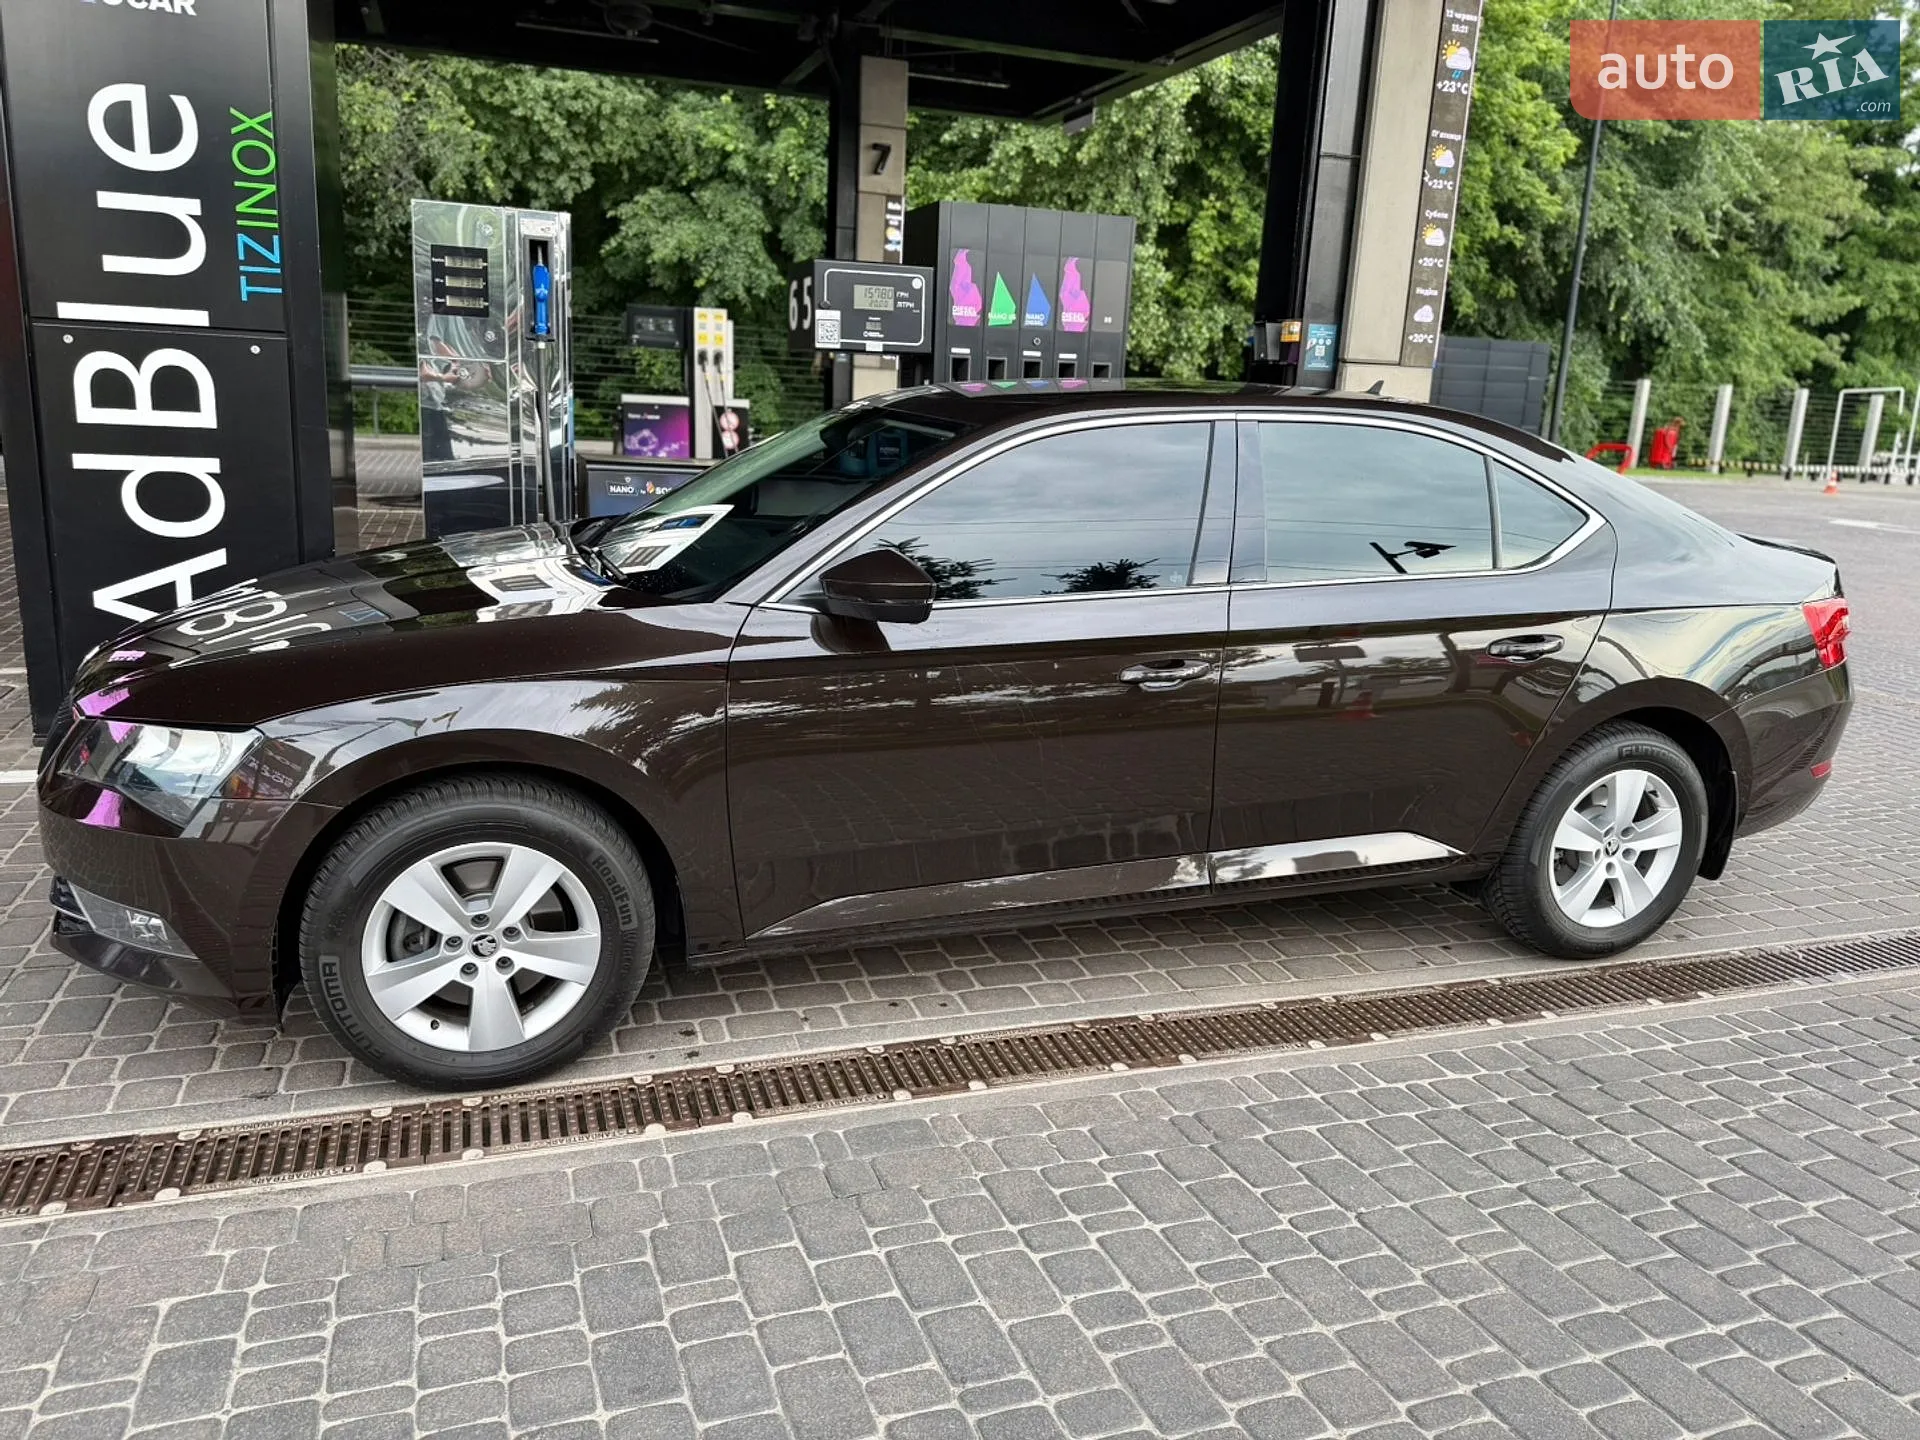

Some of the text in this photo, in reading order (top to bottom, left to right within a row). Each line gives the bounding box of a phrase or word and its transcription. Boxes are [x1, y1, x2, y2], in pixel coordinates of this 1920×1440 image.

[871, 142, 892, 176] 7
[229, 106, 283, 302] TIZINOX
[789, 276, 812, 331] 65
[56, 82, 228, 623] AdBlue
[591, 854, 634, 926] RoadFun
